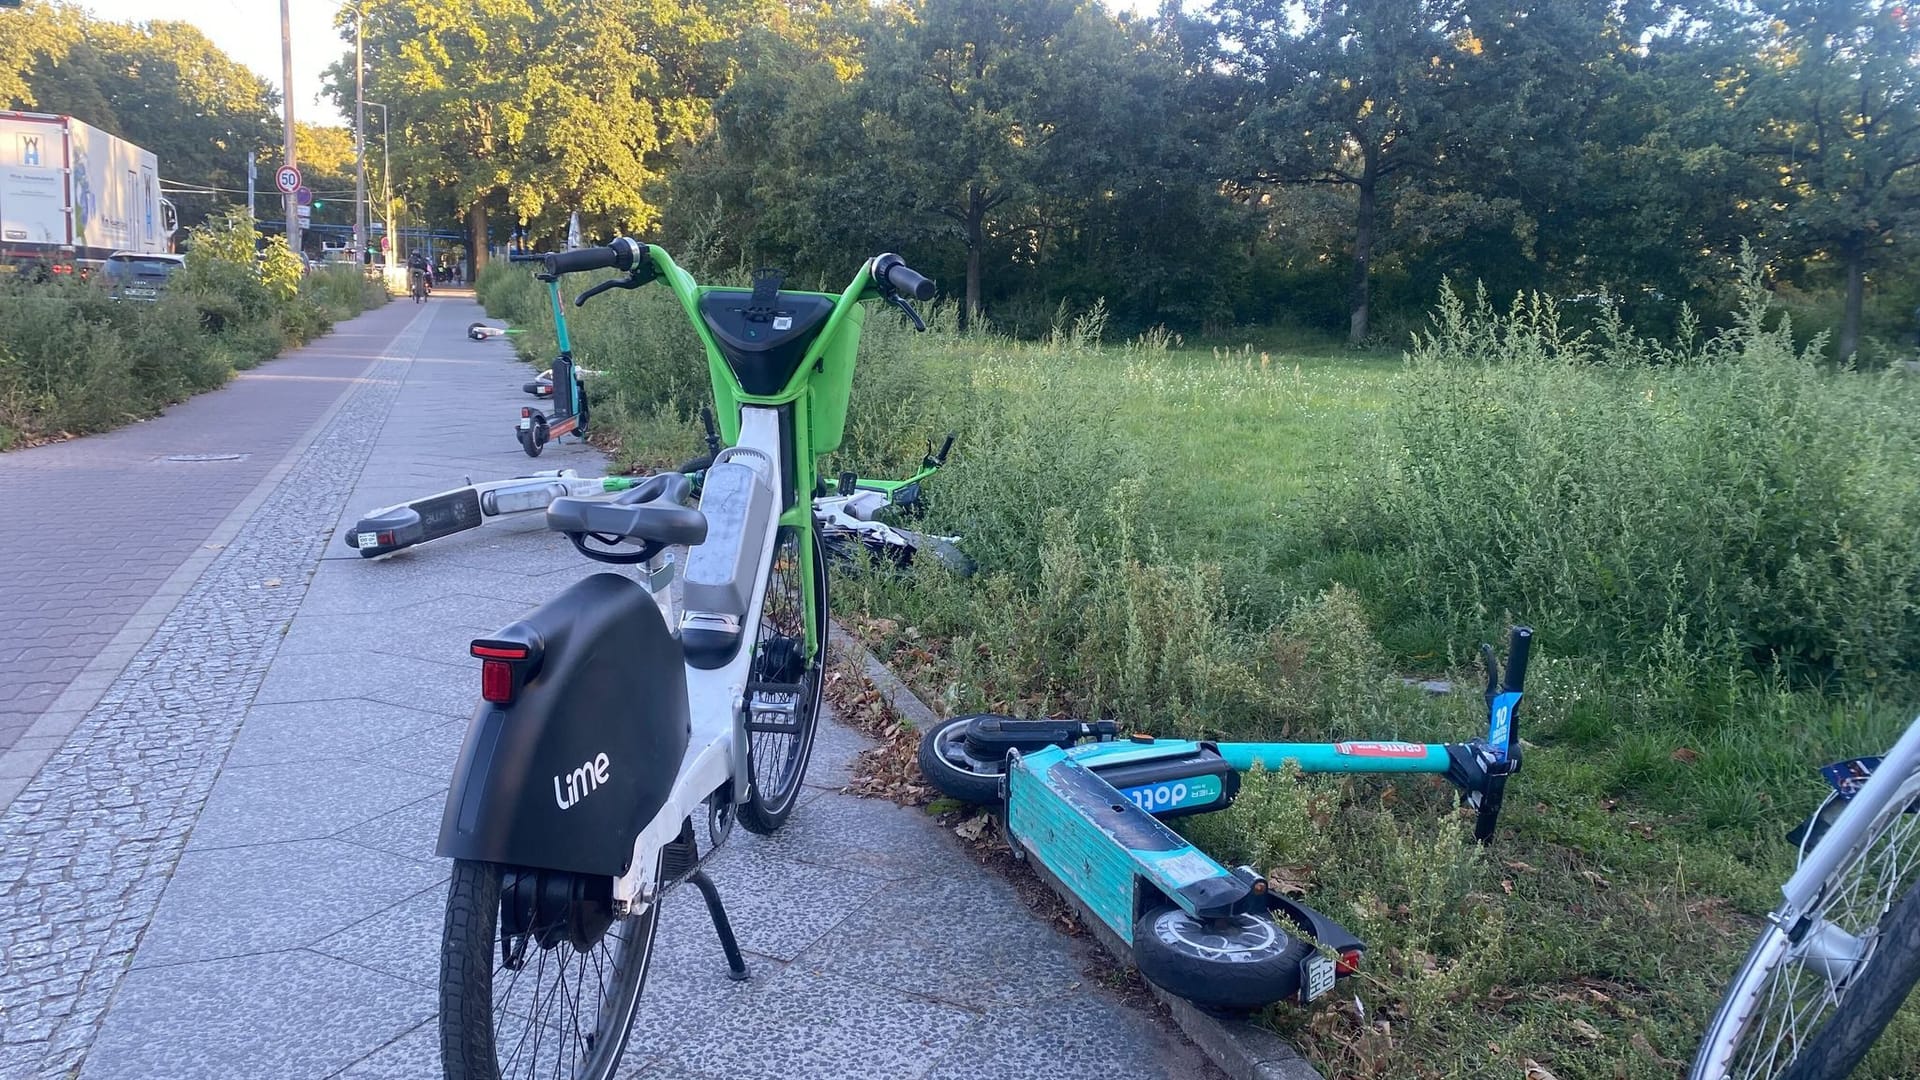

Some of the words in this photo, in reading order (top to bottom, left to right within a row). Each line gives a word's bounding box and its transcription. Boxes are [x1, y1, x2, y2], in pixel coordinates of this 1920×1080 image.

[281, 173, 296, 186] 50
[1496, 706, 1508, 728] 10
[553, 752, 610, 810] Lime
[1132, 783, 1188, 810] dott
[1191, 789, 1216, 799] TIER
